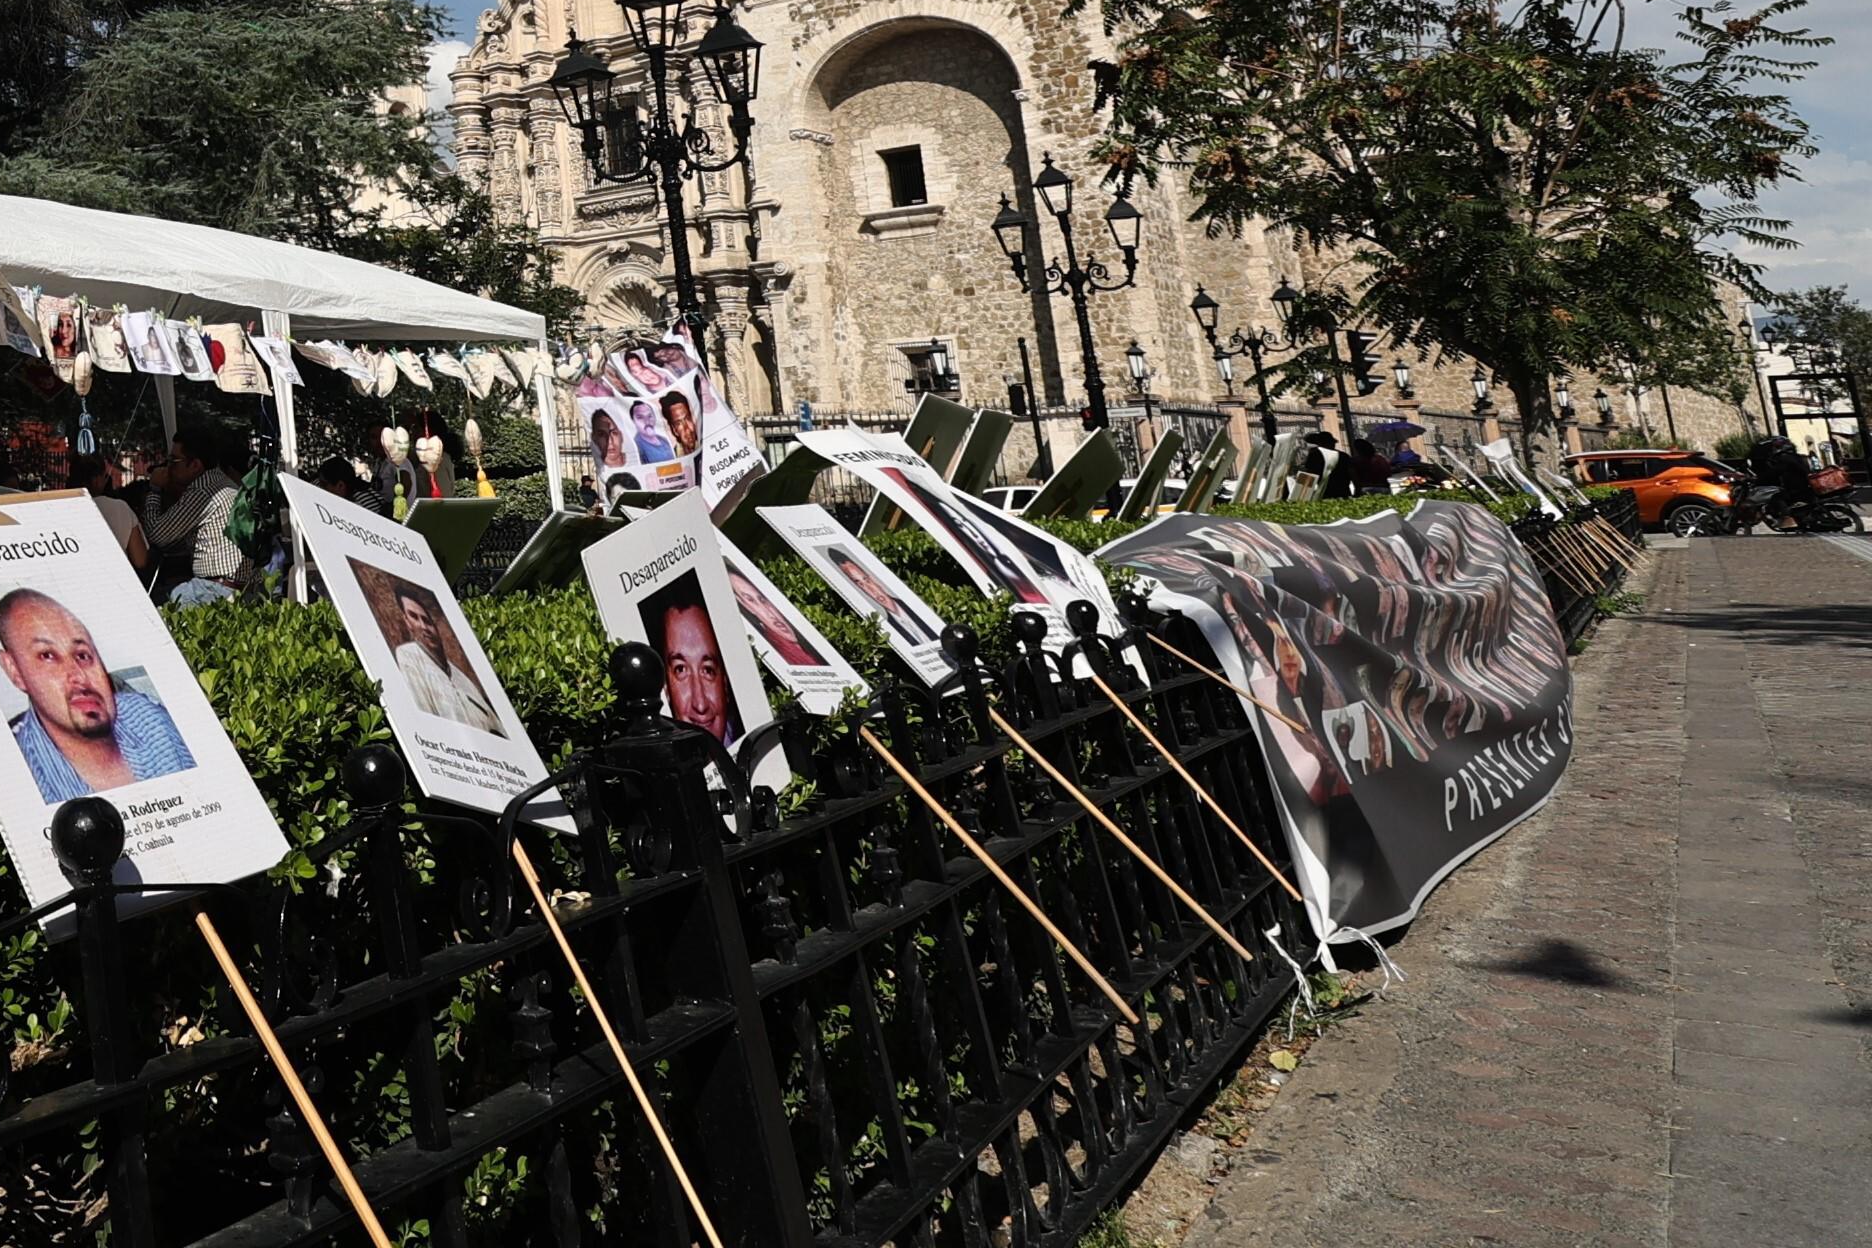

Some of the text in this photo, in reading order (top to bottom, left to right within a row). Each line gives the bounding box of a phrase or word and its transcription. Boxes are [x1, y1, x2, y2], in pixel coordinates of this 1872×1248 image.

[709, 446, 751, 476] BUSCAMOS
[315, 502, 422, 565] Desaparecido
[619, 534, 697, 594] Desaparecido
[1445, 718, 1556, 831] PRESENTES
[134, 826, 143, 837] el
[142, 822, 153, 834] 29
[154, 818, 165, 830] de
[166, 812, 191, 827] agosto
[193, 808, 203, 820] de
[203, 802, 222, 816] 2009
[137, 835, 174, 853] Coahuila
